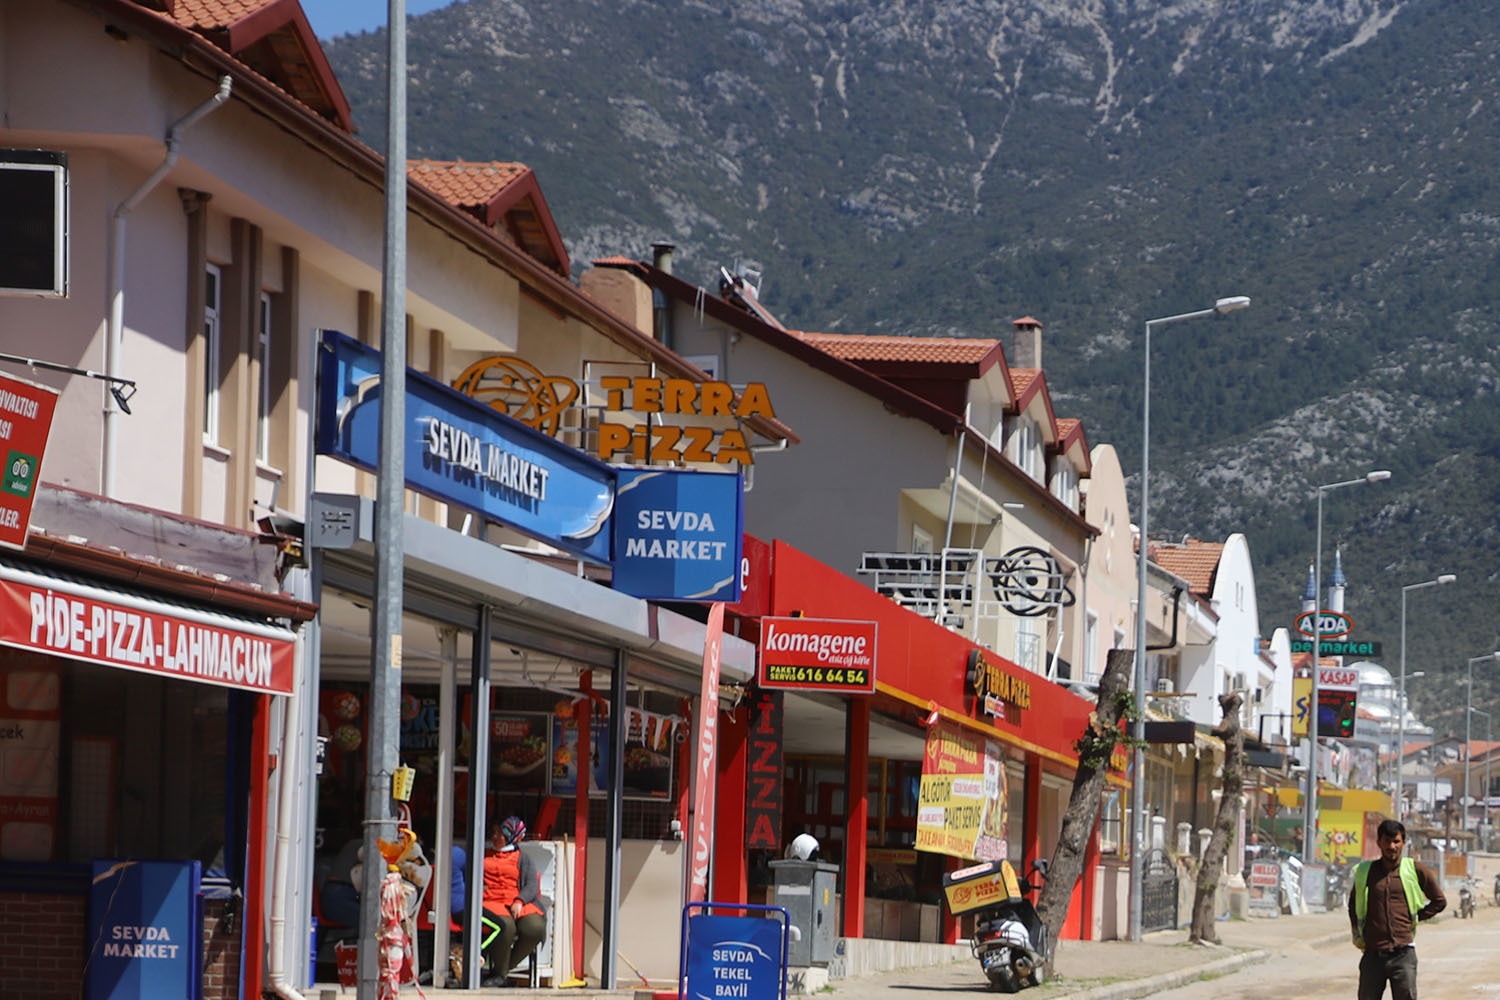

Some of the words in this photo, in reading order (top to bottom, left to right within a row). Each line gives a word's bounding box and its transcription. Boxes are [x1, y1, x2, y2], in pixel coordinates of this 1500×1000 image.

[600, 376, 774, 417] TERRA
[428, 417, 482, 473] SEVDA
[487, 443, 549, 501] MARKET
[637, 510, 714, 532] SEVDA
[625, 538, 727, 562] MARKET
[766, 624, 866, 661] komagene
[770, 666, 797, 674] PAKET
[797, 668, 823, 681] 616
[826, 669, 844, 683] 64
[847, 670, 865, 684] 54
[1320, 671, 1356, 685] KASAP
[986, 663, 1010, 701] TERRA
[112, 925, 170, 942] SEVDA
[104, 943, 179, 960] MARKET
[713, 949, 754, 963] SEVDA
[713, 967, 752, 980] TEKEL
